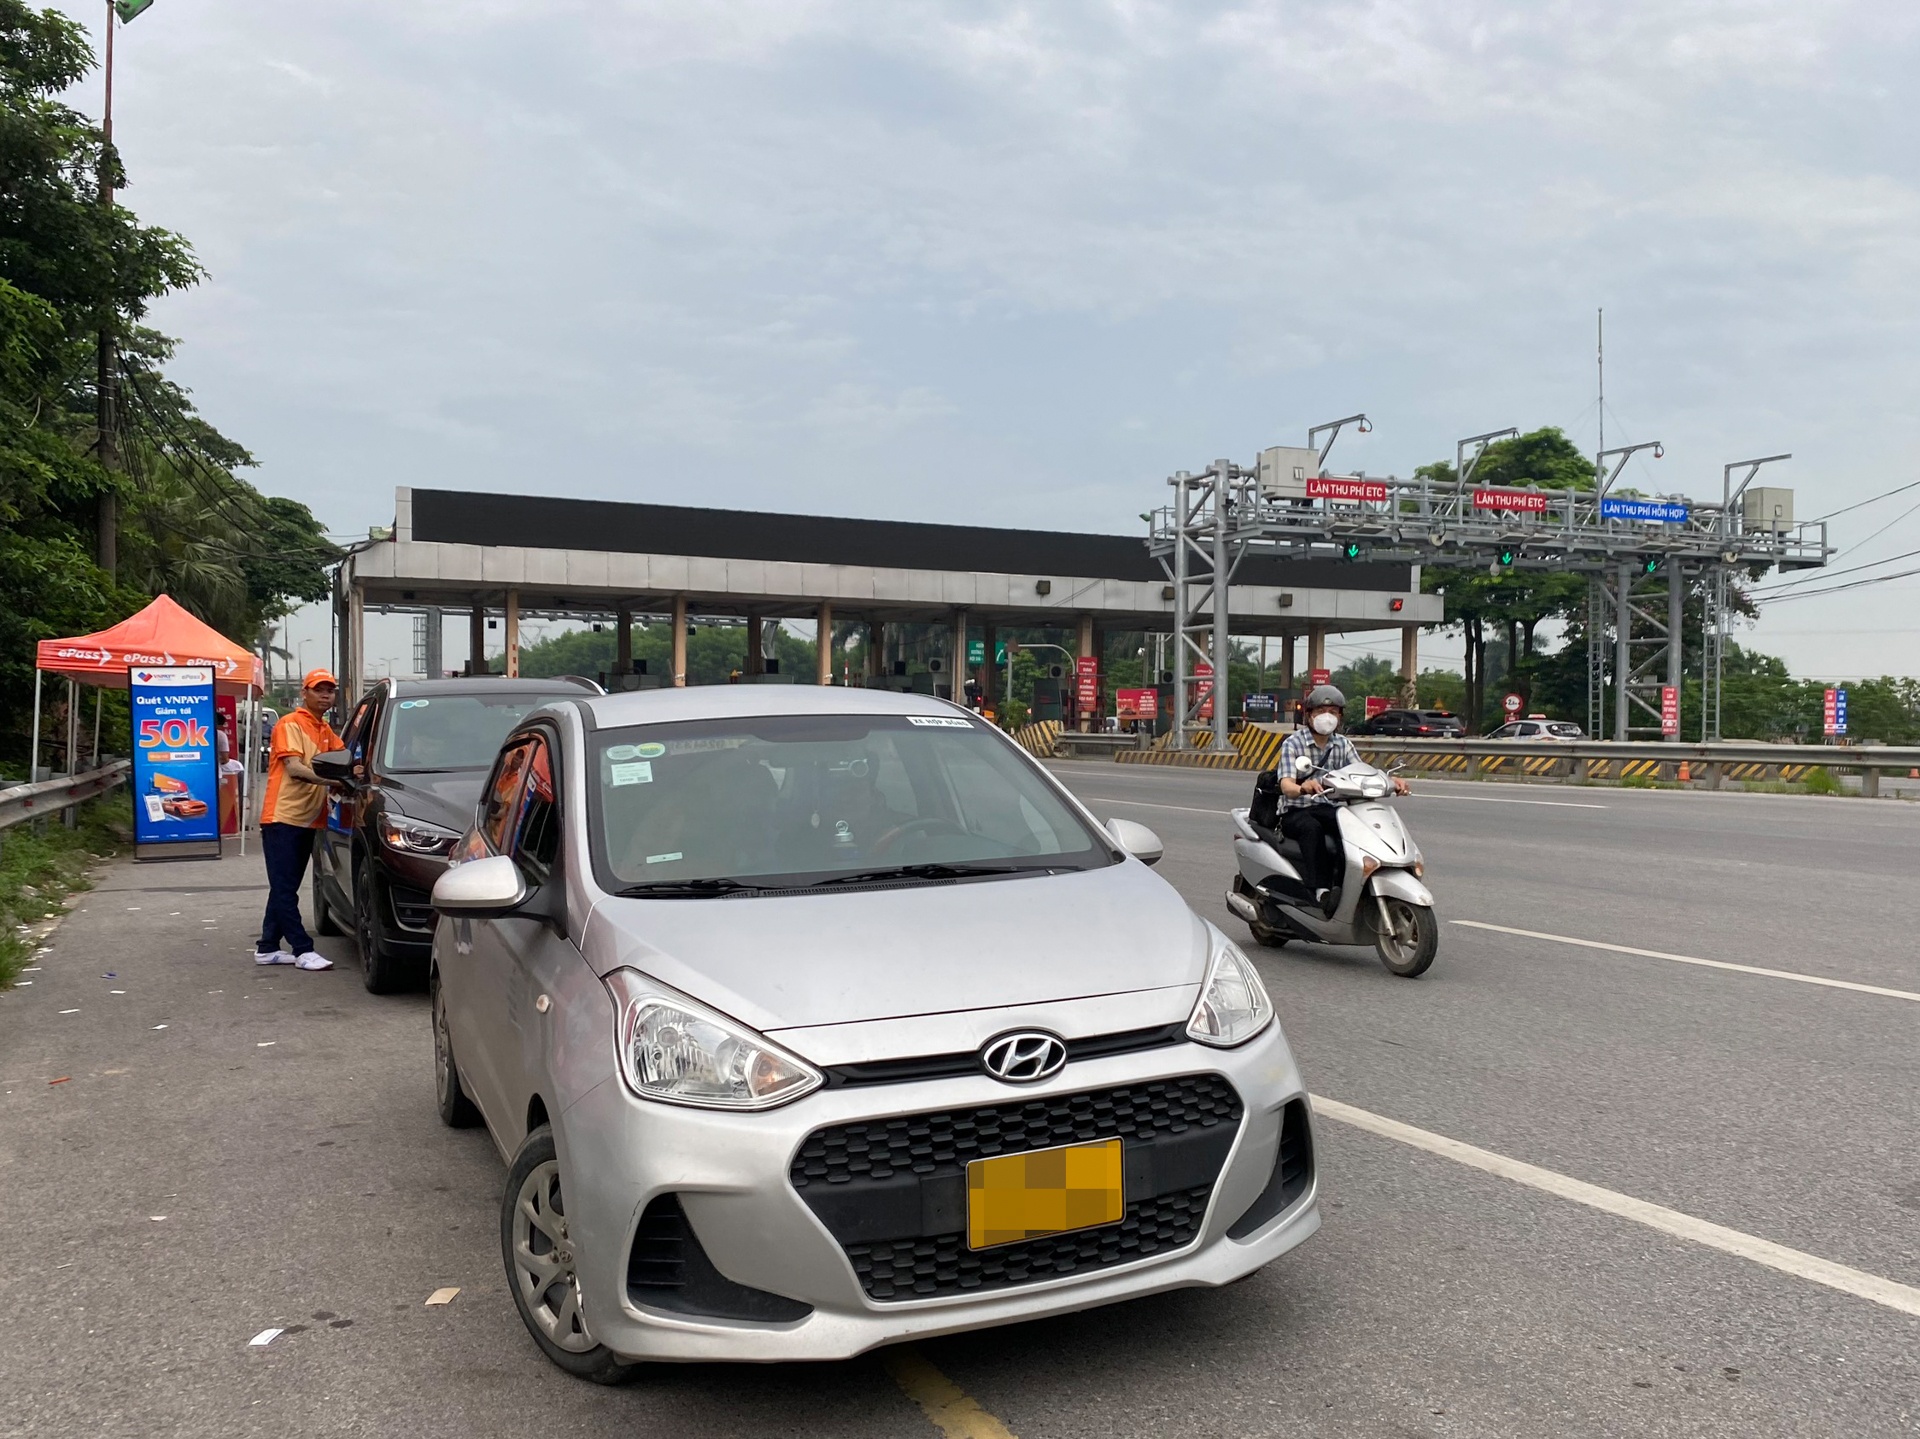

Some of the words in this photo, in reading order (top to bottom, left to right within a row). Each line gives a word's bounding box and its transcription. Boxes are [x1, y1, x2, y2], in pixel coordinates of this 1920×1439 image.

[1310, 480, 1329, 494] LÀN
[1331, 484, 1348, 495] THU
[1350, 483, 1365, 496] PHÍ
[1366, 486, 1383, 497] ETC
[1476, 492, 1494, 505] LÀN
[1495, 495, 1512, 506] THU
[1513, 495, 1527, 507] PHÍ
[1528, 498, 1544, 508] ETC
[1604, 501, 1620, 514] LÀN
[1621, 504, 1637, 515] THU
[1637, 504, 1651, 516] PHÍ
[1668, 508, 1684, 520] HỢP
[57, 648, 100, 661] ePass
[123, 653, 165, 666] ePass
[186, 658, 227, 669] ePass
[136, 696, 162, 705] Quét
[138, 718, 210, 748] 50k
